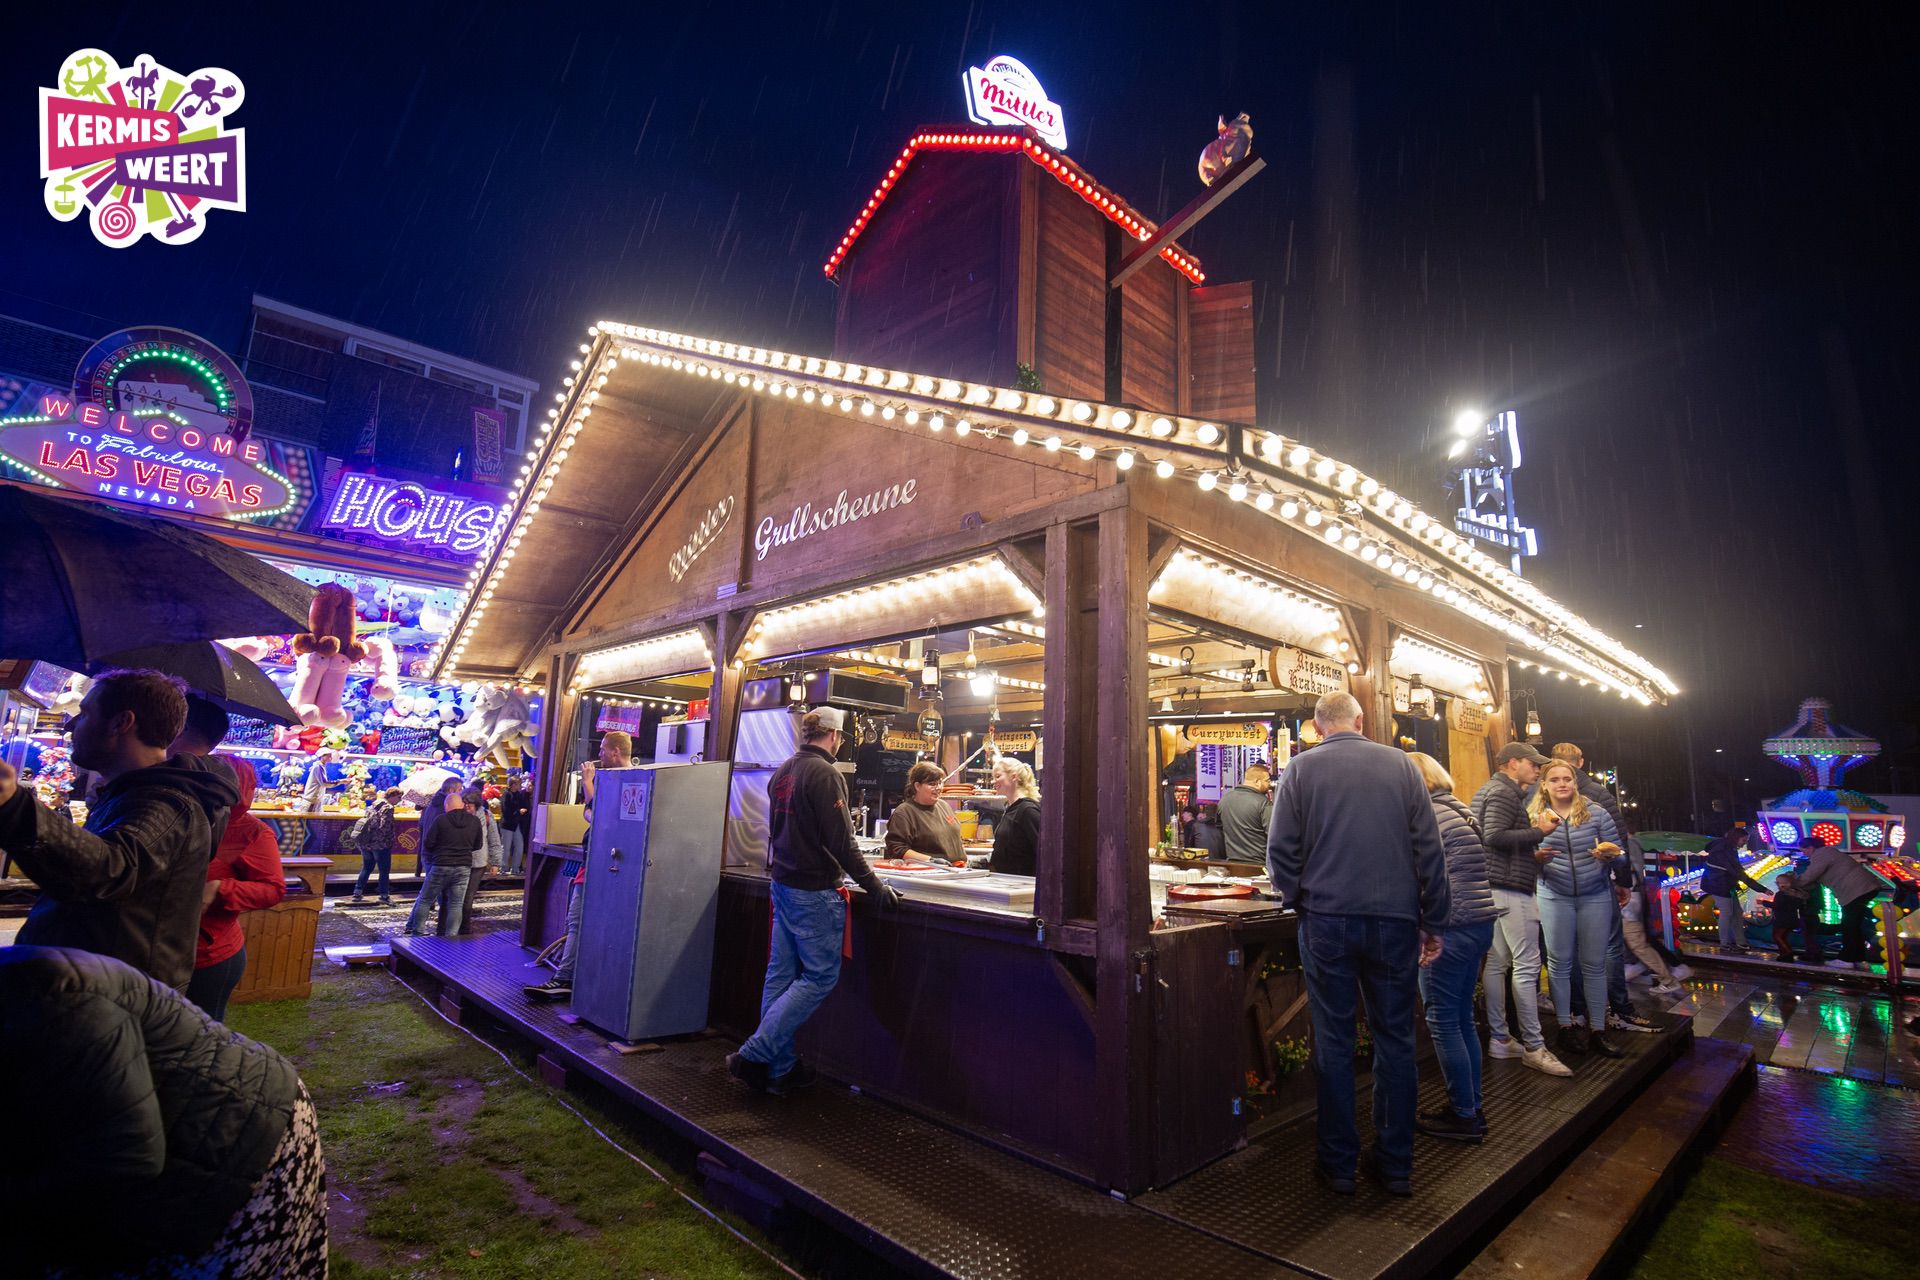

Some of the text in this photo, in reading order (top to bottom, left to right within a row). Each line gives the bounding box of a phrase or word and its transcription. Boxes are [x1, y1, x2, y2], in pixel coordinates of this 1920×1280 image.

[45, 397, 259, 461] WELCOME
[67, 431, 224, 474] TO Fabulous
[39, 441, 264, 507] LAS VEGAS
[99, 482, 195, 509] NEVADA
[755, 479, 917, 561] Grillscheune
[1191, 726, 1262, 742] Currywurst
